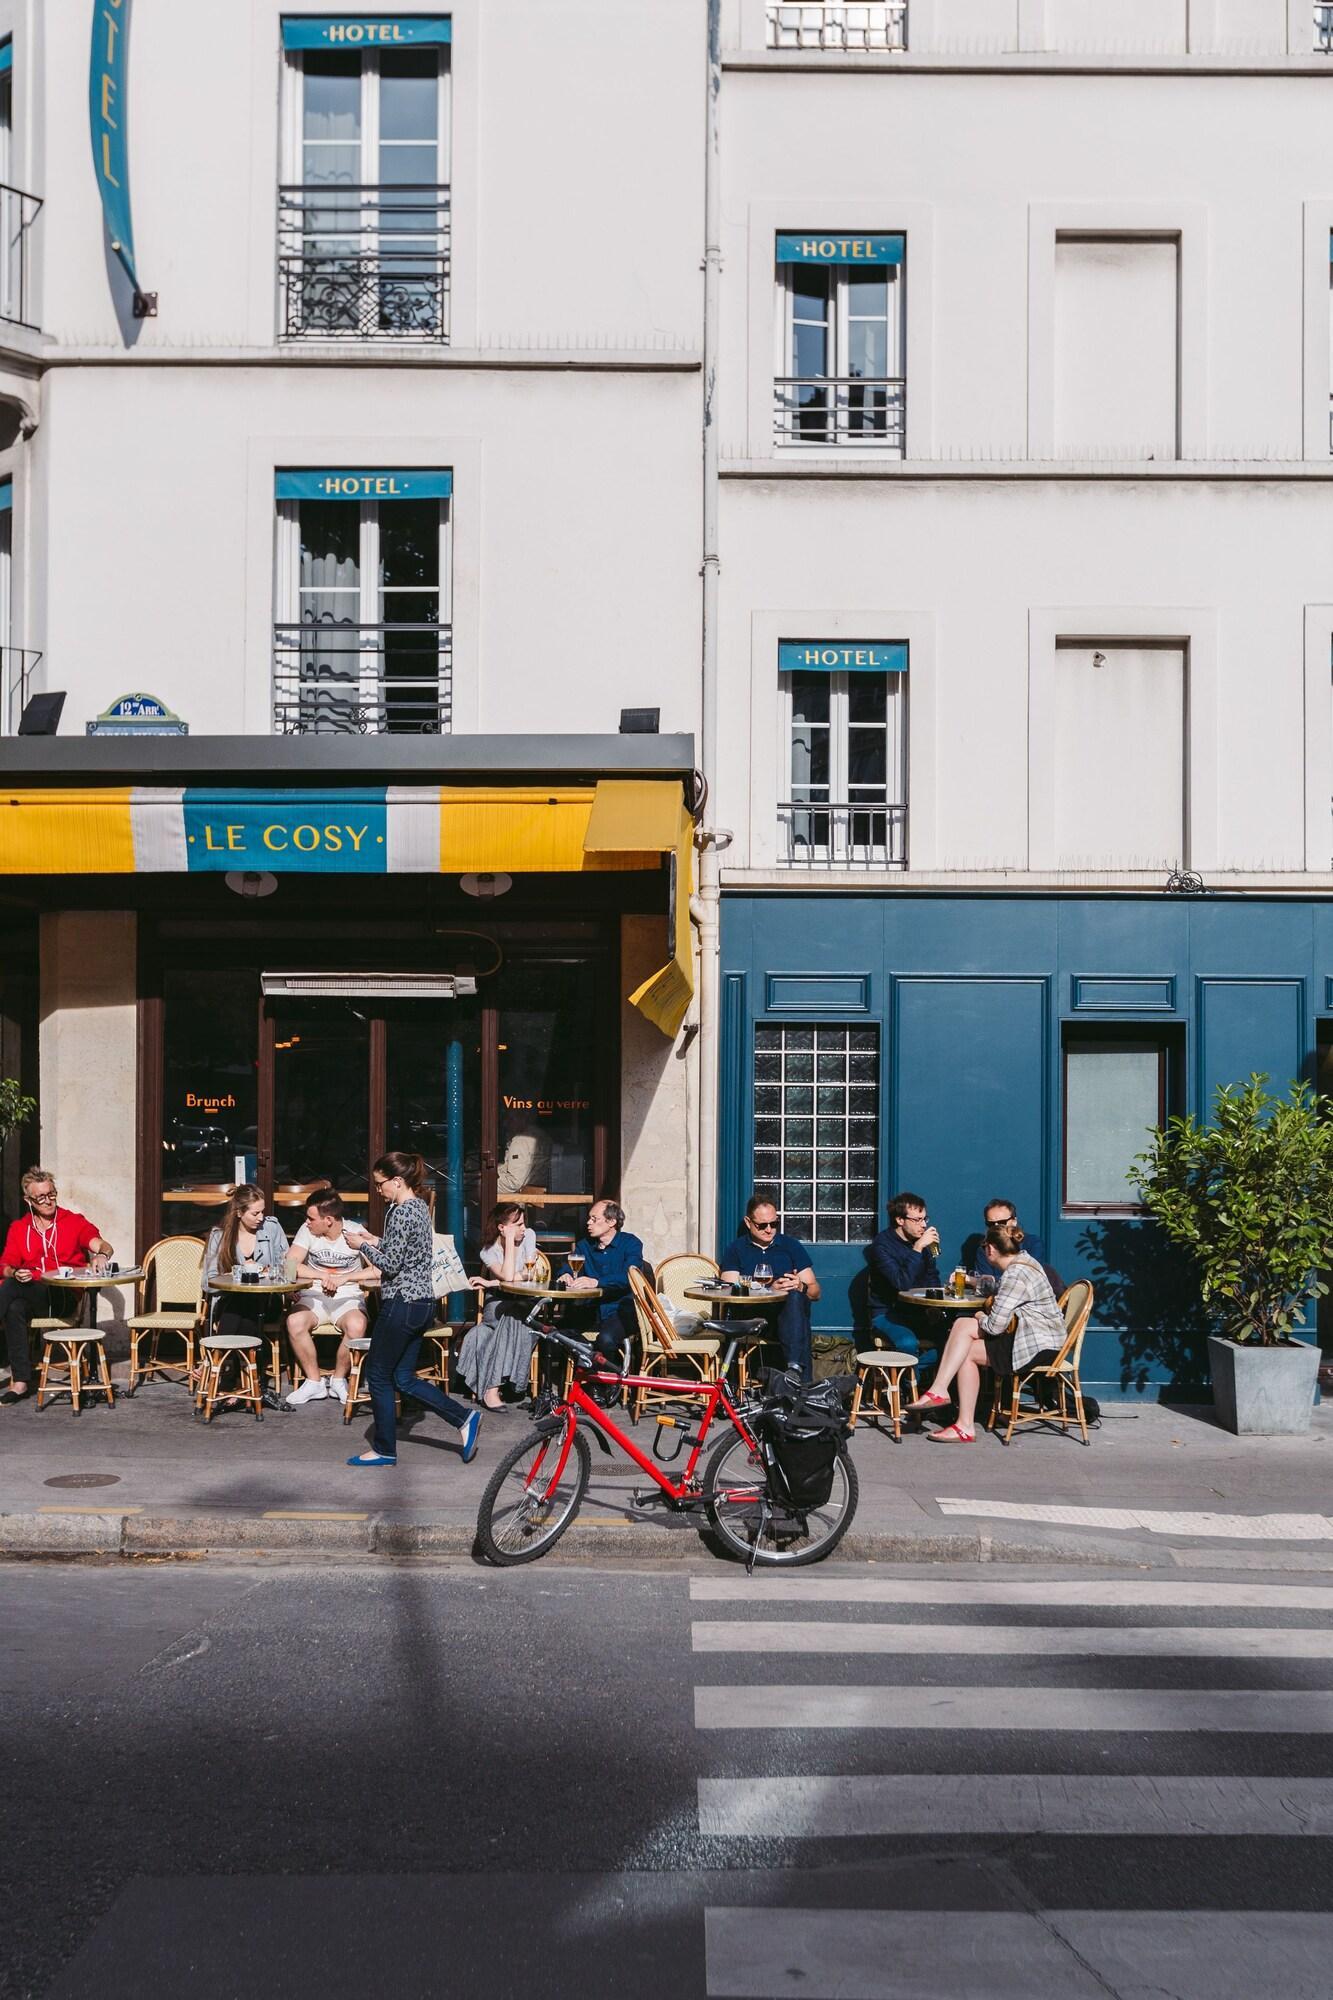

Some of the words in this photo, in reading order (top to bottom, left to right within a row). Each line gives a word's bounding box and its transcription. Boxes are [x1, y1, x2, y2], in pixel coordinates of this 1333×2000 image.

[329, 24, 405, 42] HOTEL
[103, 0, 122, 189] TEL
[802, 239, 878, 258] HOTEL
[325, 477, 401, 495] HOTEL
[805, 649, 881, 666] HOTEL
[204, 824, 247, 851] LE
[263, 823, 369, 852] COSY
[186, 1092, 236, 1108] Brunch
[503, 1094, 533, 1109] Vins
[537, 1099, 554, 1110] au
